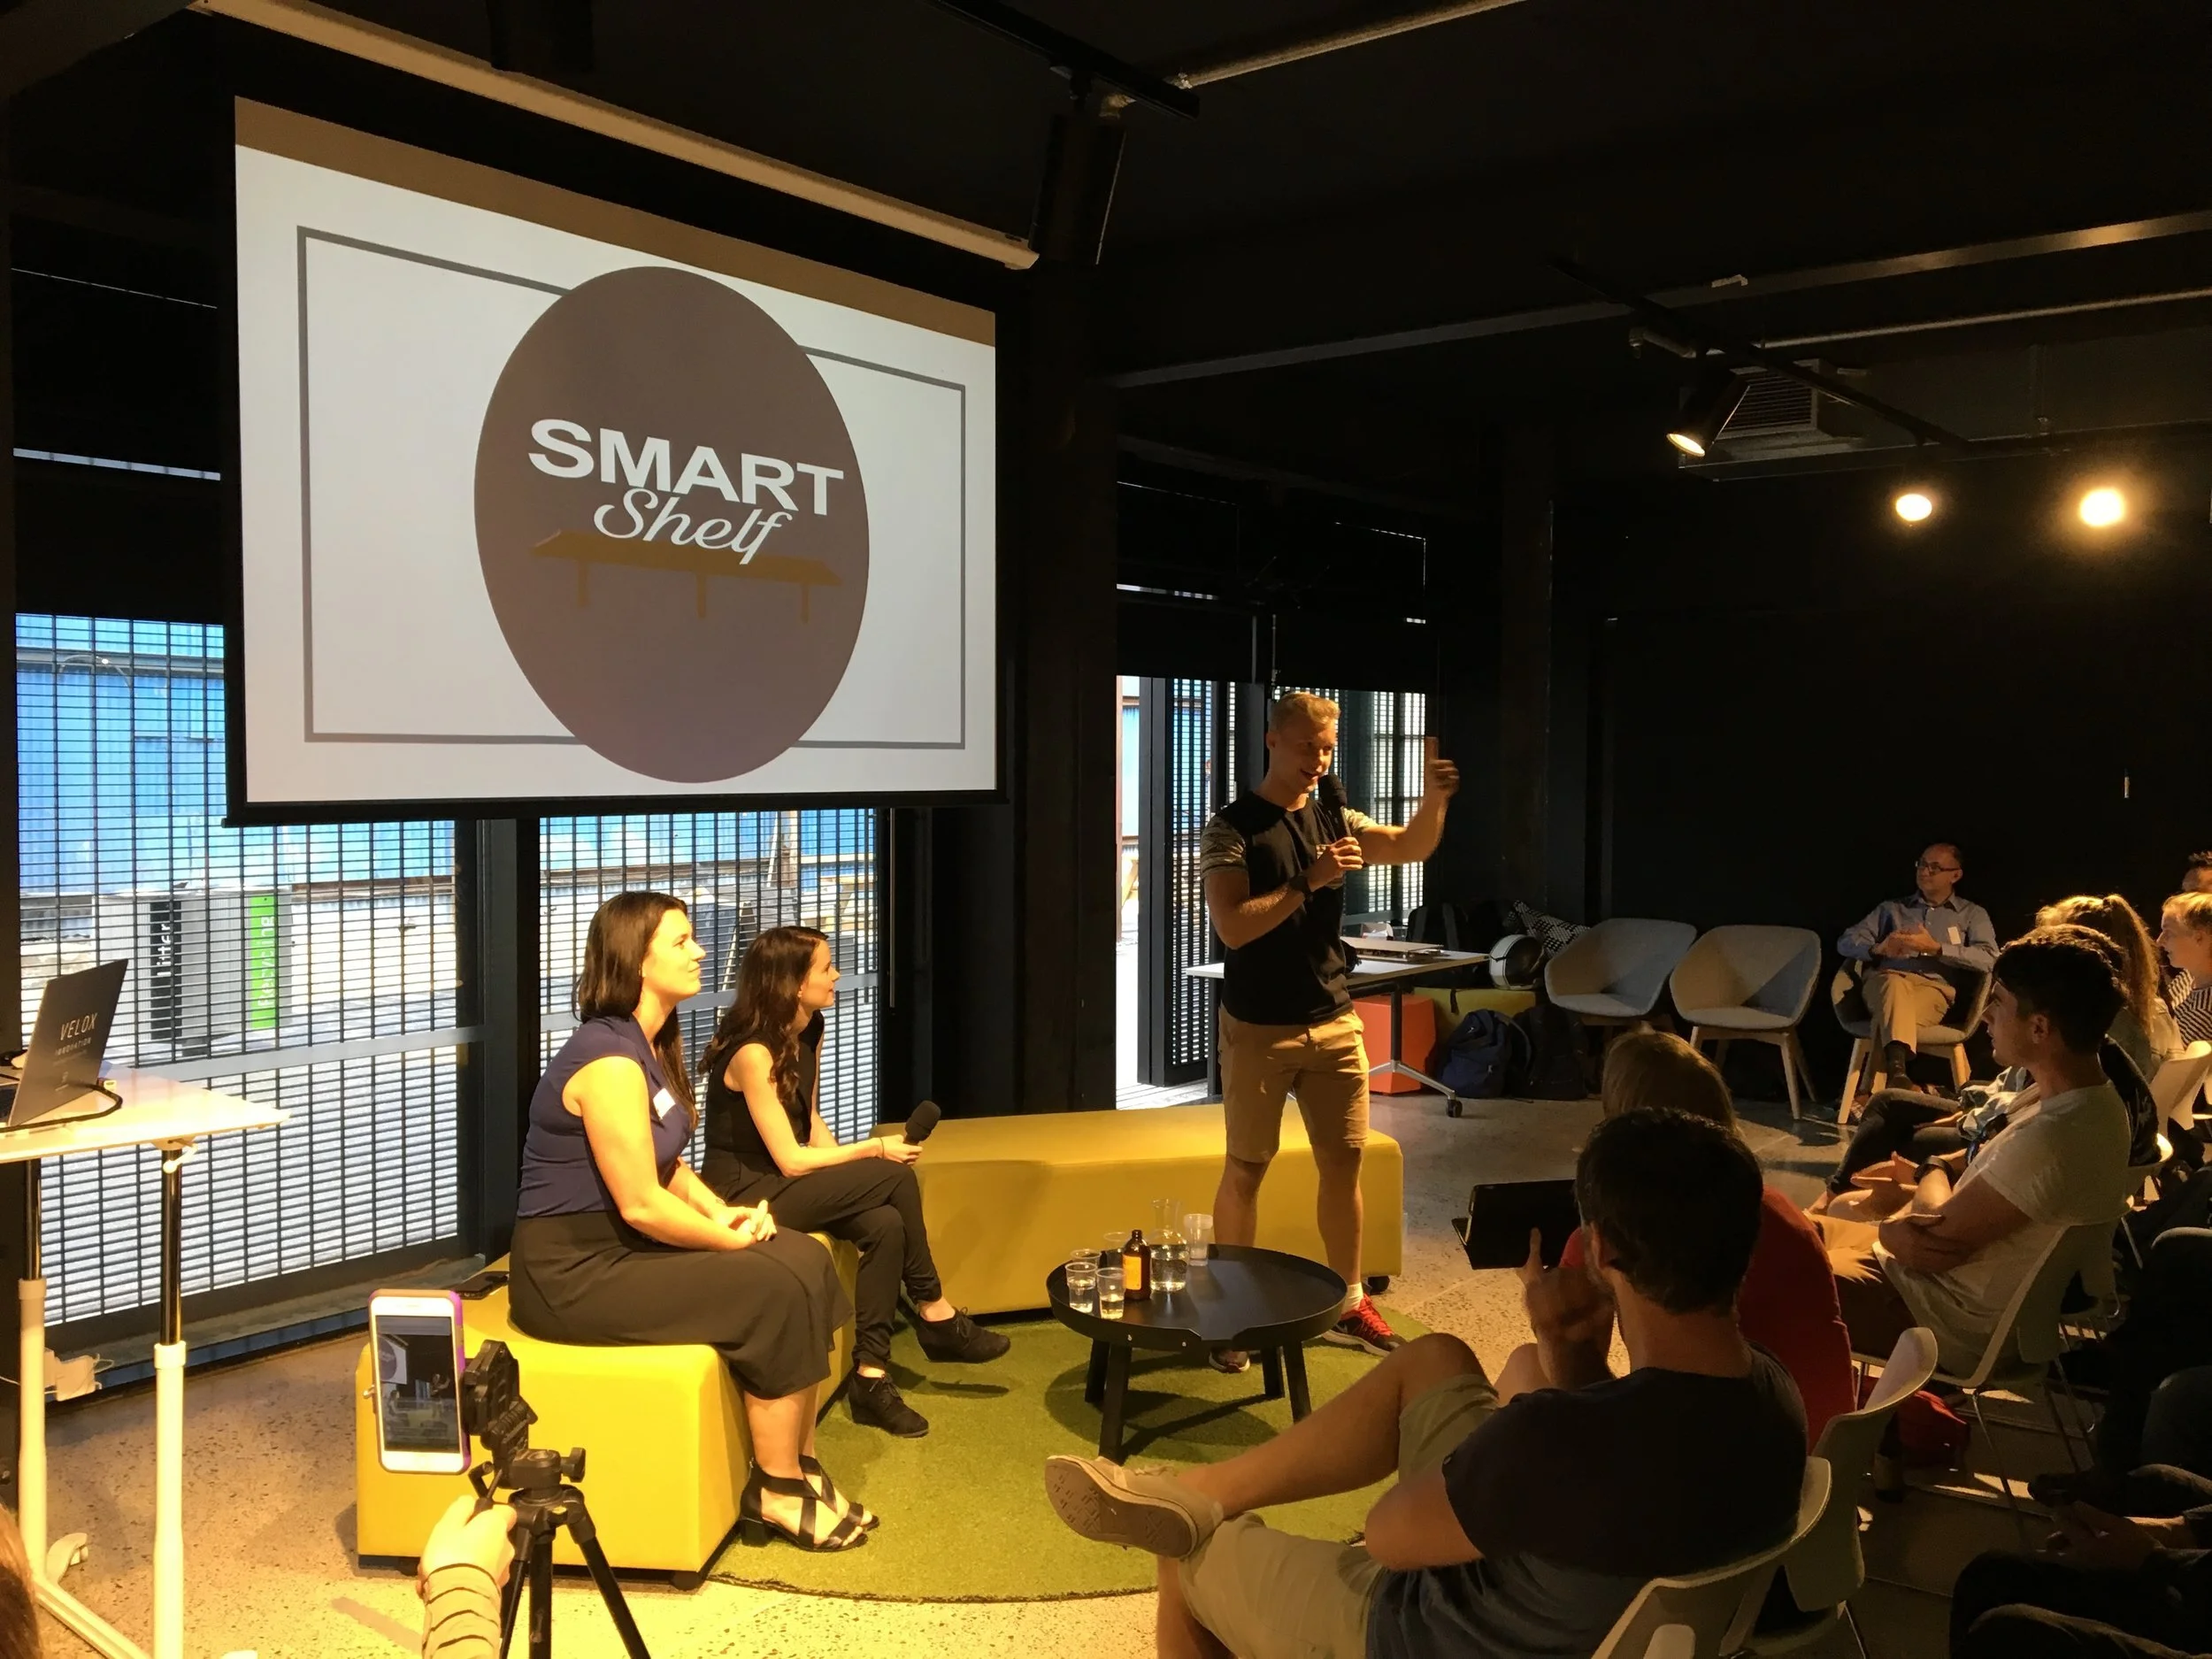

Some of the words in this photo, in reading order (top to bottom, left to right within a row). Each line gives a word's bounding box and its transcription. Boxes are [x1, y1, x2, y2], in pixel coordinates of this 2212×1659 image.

[528, 419, 843, 515] SMART
[594, 488, 793, 565] Shelf
[257, 916, 276, 1007] Recycing
[60, 1012, 97, 1041] VELOX
